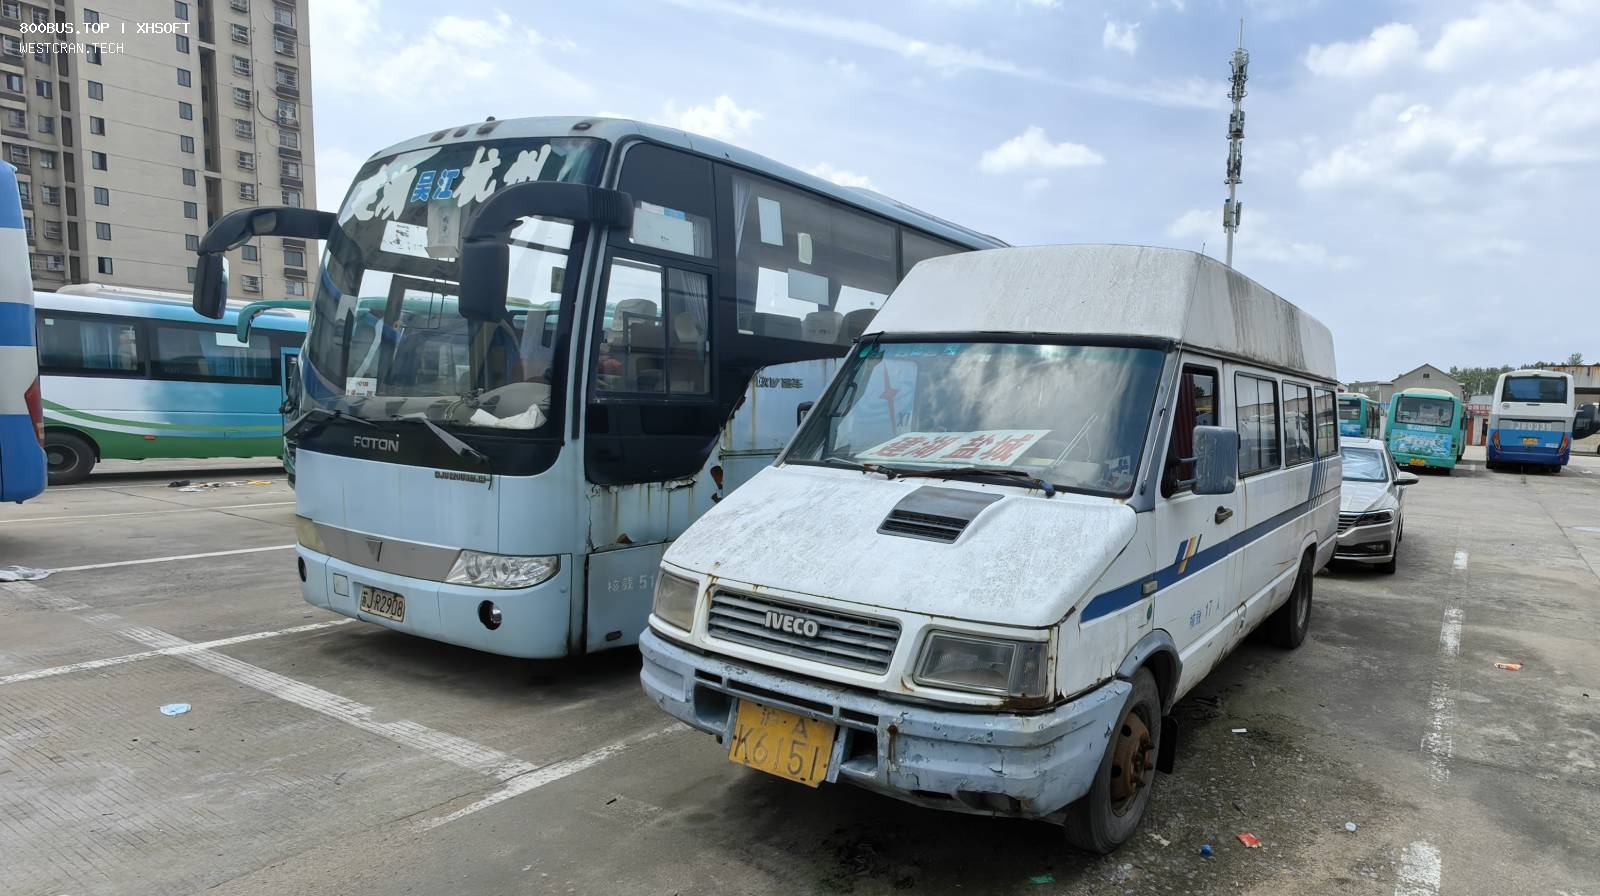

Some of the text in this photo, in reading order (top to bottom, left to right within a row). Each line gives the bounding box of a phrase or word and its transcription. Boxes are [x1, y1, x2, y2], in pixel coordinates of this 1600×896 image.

[410, 169, 460, 203] 吴江
[353, 435, 400, 452] FOTON
[940, 433, 1036, 462] 盐城
[764, 611, 819, 638] IVECO
[733, 723, 820, 782] K6151
